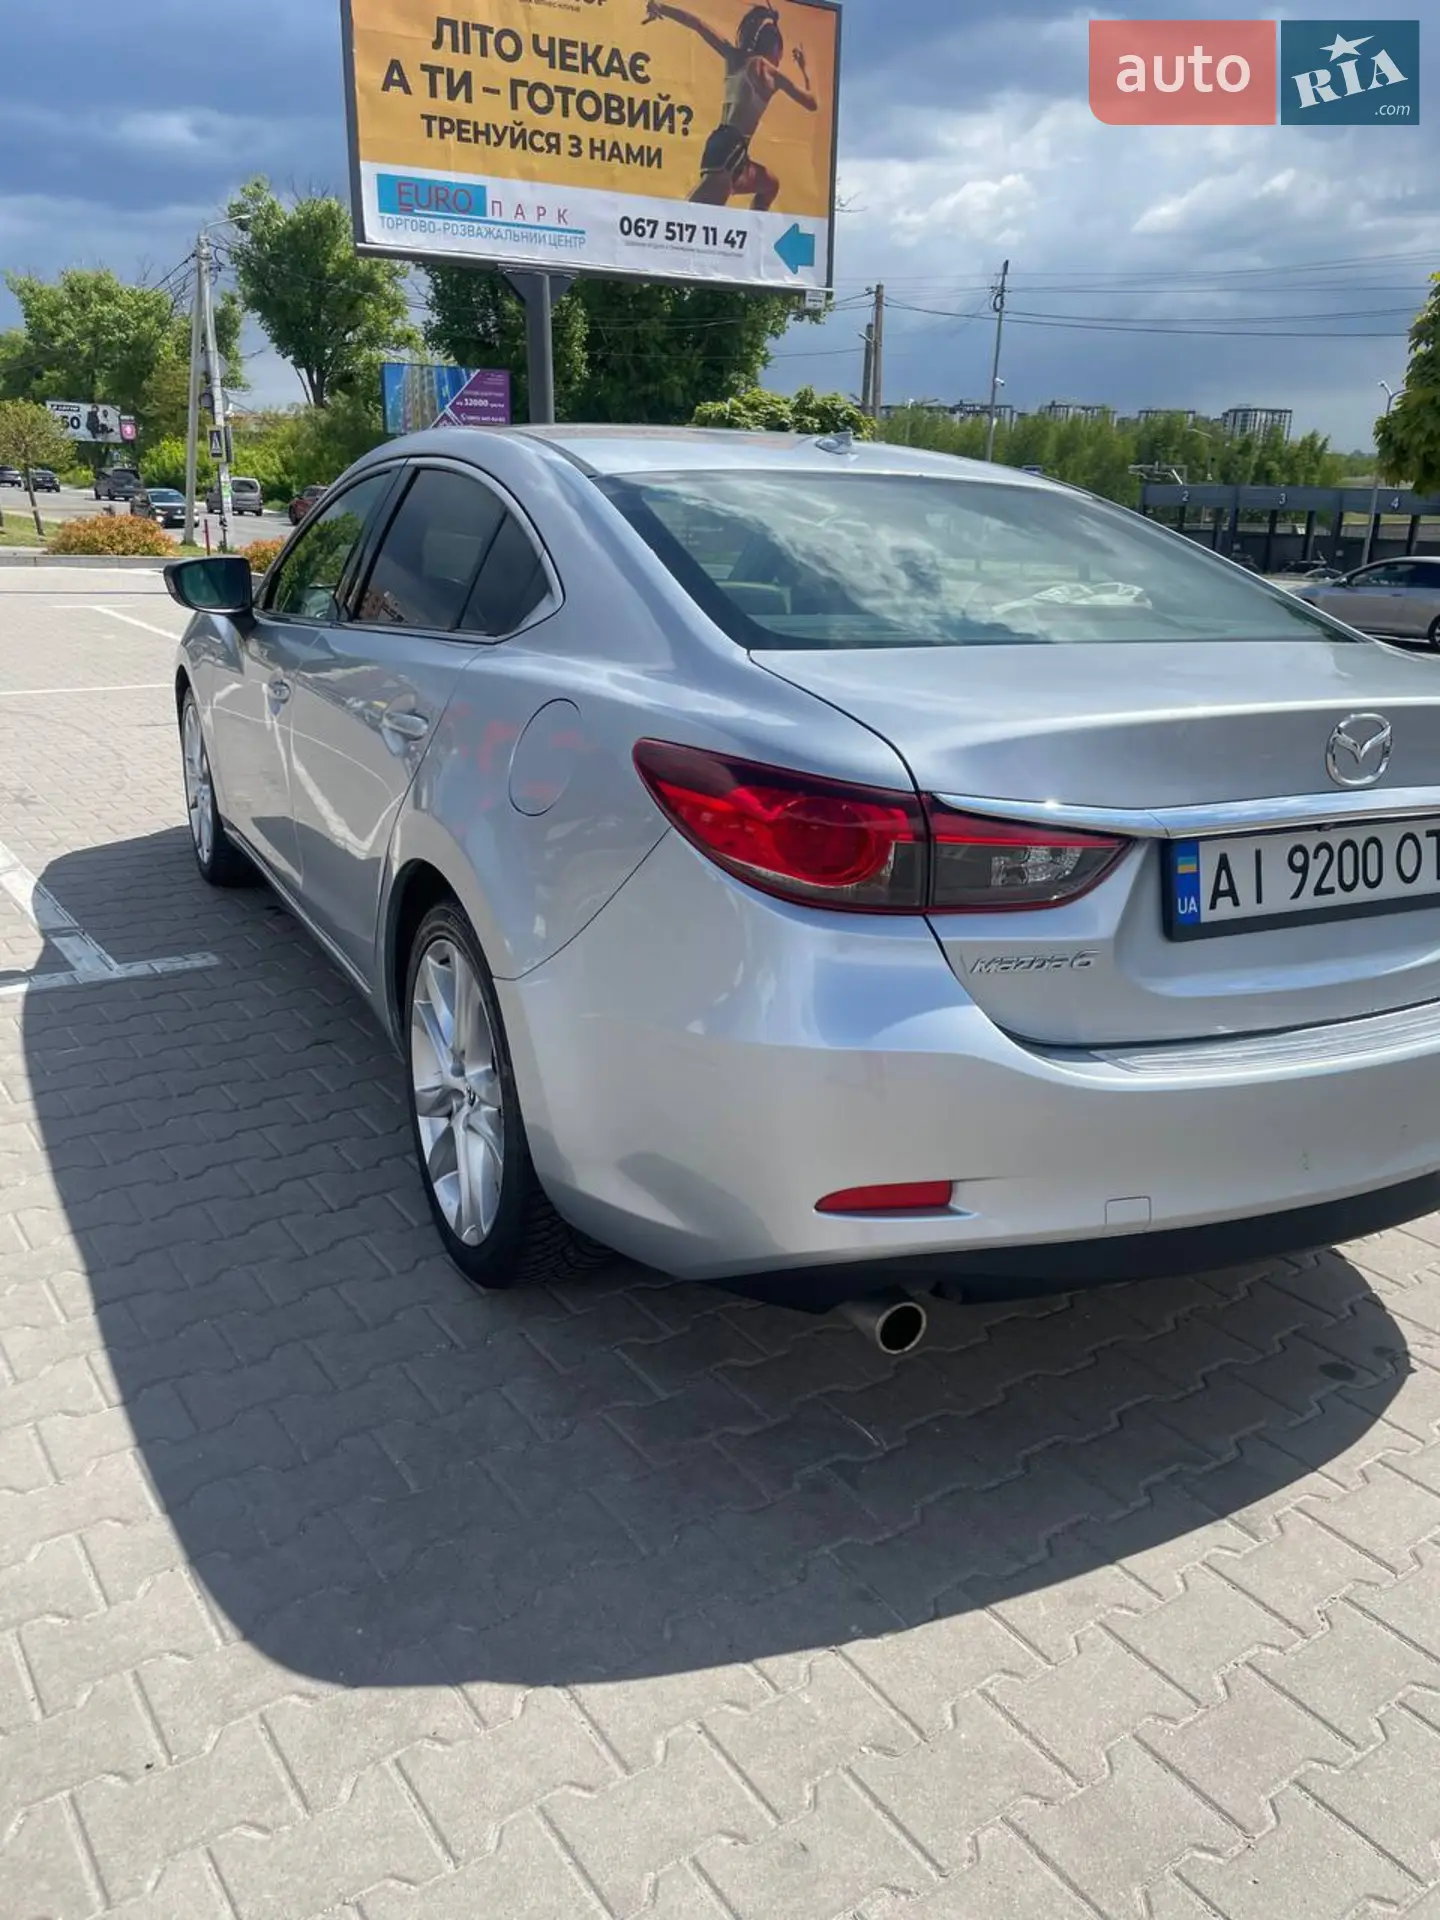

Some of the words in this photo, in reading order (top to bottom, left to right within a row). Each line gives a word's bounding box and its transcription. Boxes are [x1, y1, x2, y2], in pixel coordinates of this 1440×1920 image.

[431, 16, 523, 63] ЛІТО
[532, 33, 651, 85] ЧЕКАЄ
[381, 59, 412, 95] А
[420, 64, 473, 104] ТИ
[509, 77, 694, 137] ГОТОВИЙ?
[420, 113, 561, 156] ТРЕНУЙСЯ
[589, 137, 663, 169] НАМИ
[396, 181, 473, 214] EURO
[491, 199, 569, 225] ПАРК
[549, 233, 586, 250] ЦЕНТР
[619, 215, 659, 239] 067
[664, 221, 697, 244] 517
[702, 225, 718, 246] 11
[723, 229, 748, 249] 47
[1182, 490, 1189, 501] 2
[1278, 492, 1287, 505] 3
[1390, 496, 1400, 509] 4
[1208, 849, 1263, 911] AI
[1287, 836, 1384, 901] 9200
[1177, 897, 1199, 915] UA
